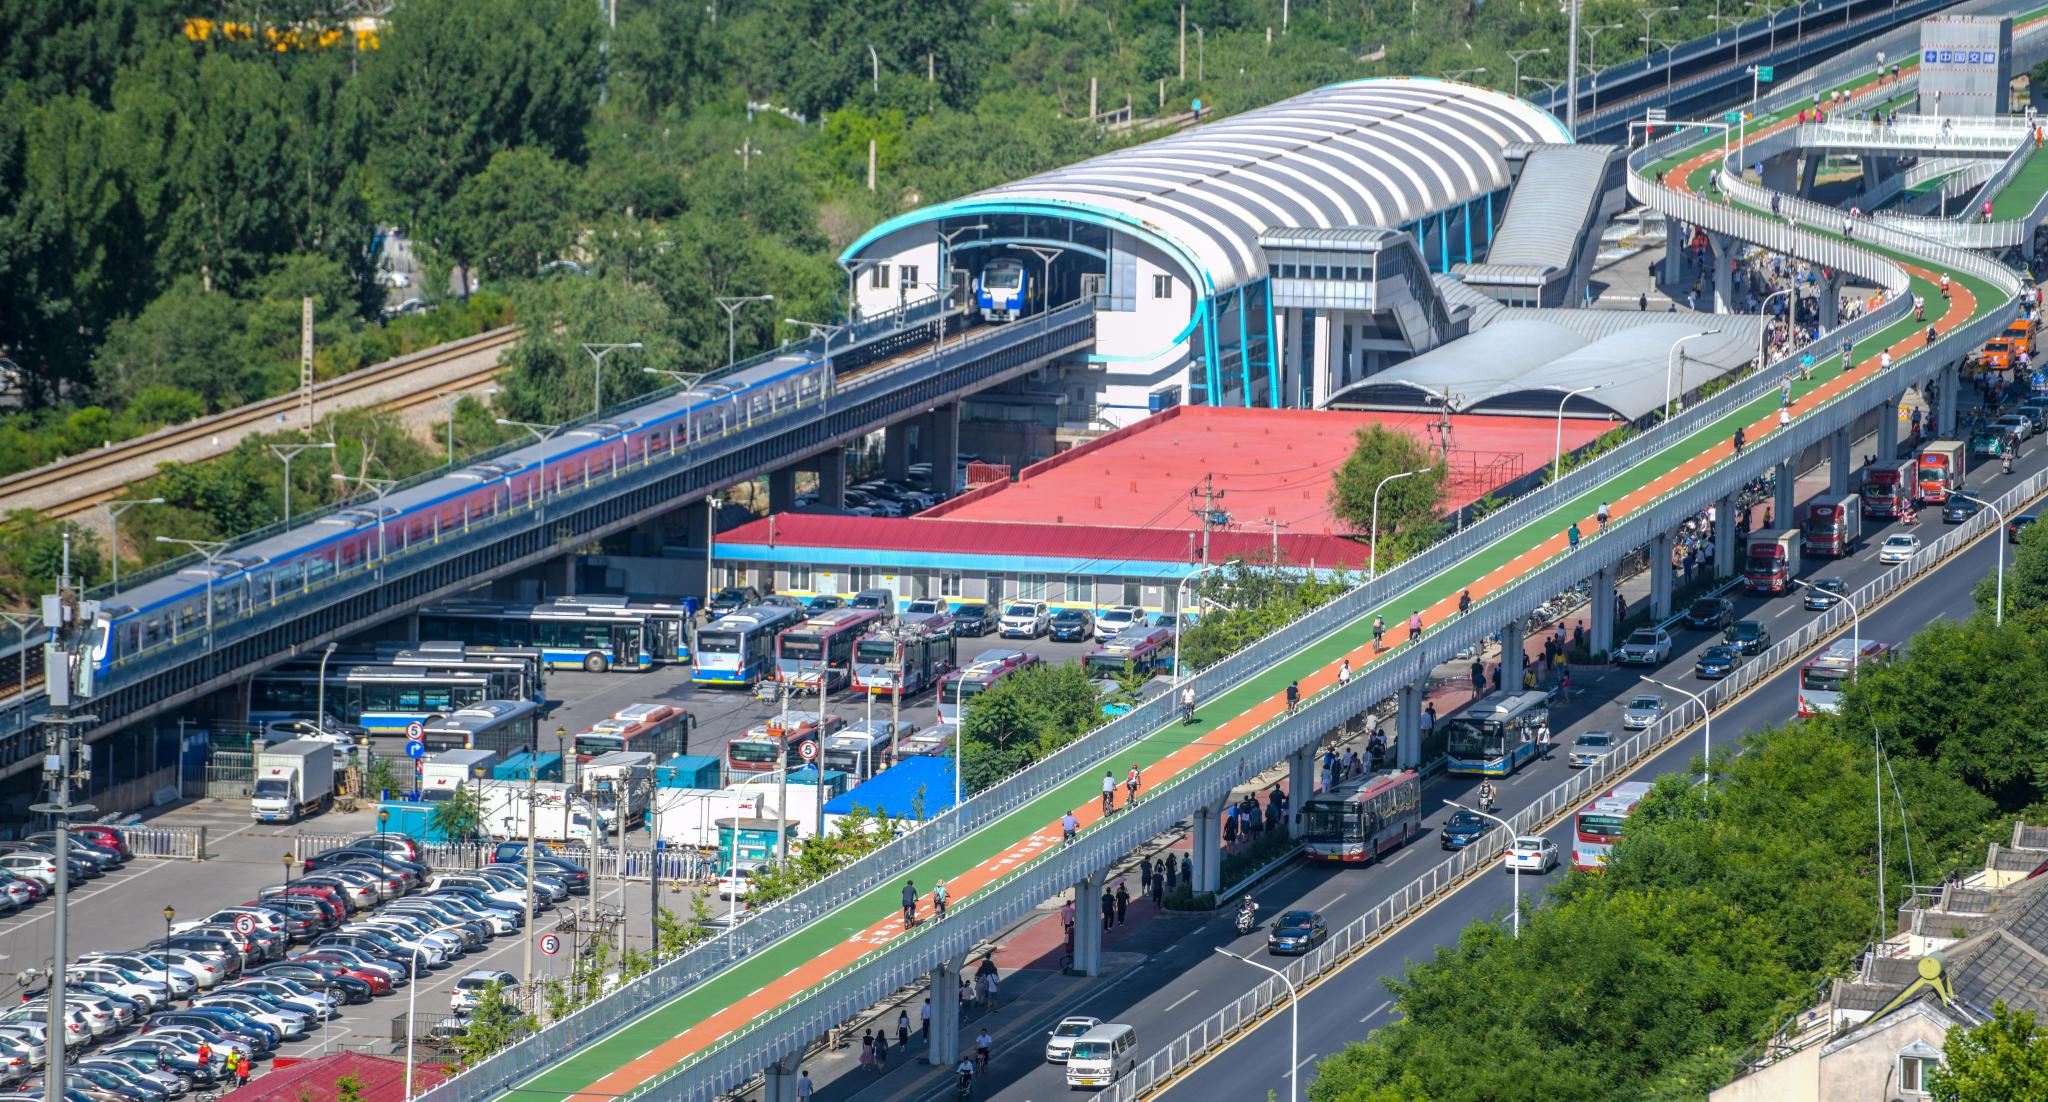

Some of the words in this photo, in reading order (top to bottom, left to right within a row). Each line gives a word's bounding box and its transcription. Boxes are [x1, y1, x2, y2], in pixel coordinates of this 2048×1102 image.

[1940, 51, 1995, 64] 中国交建
[411, 726, 418, 735] 5
[804, 745, 811, 754] 5
[241, 920, 249, 930] 5
[546, 939, 554, 950] 5
